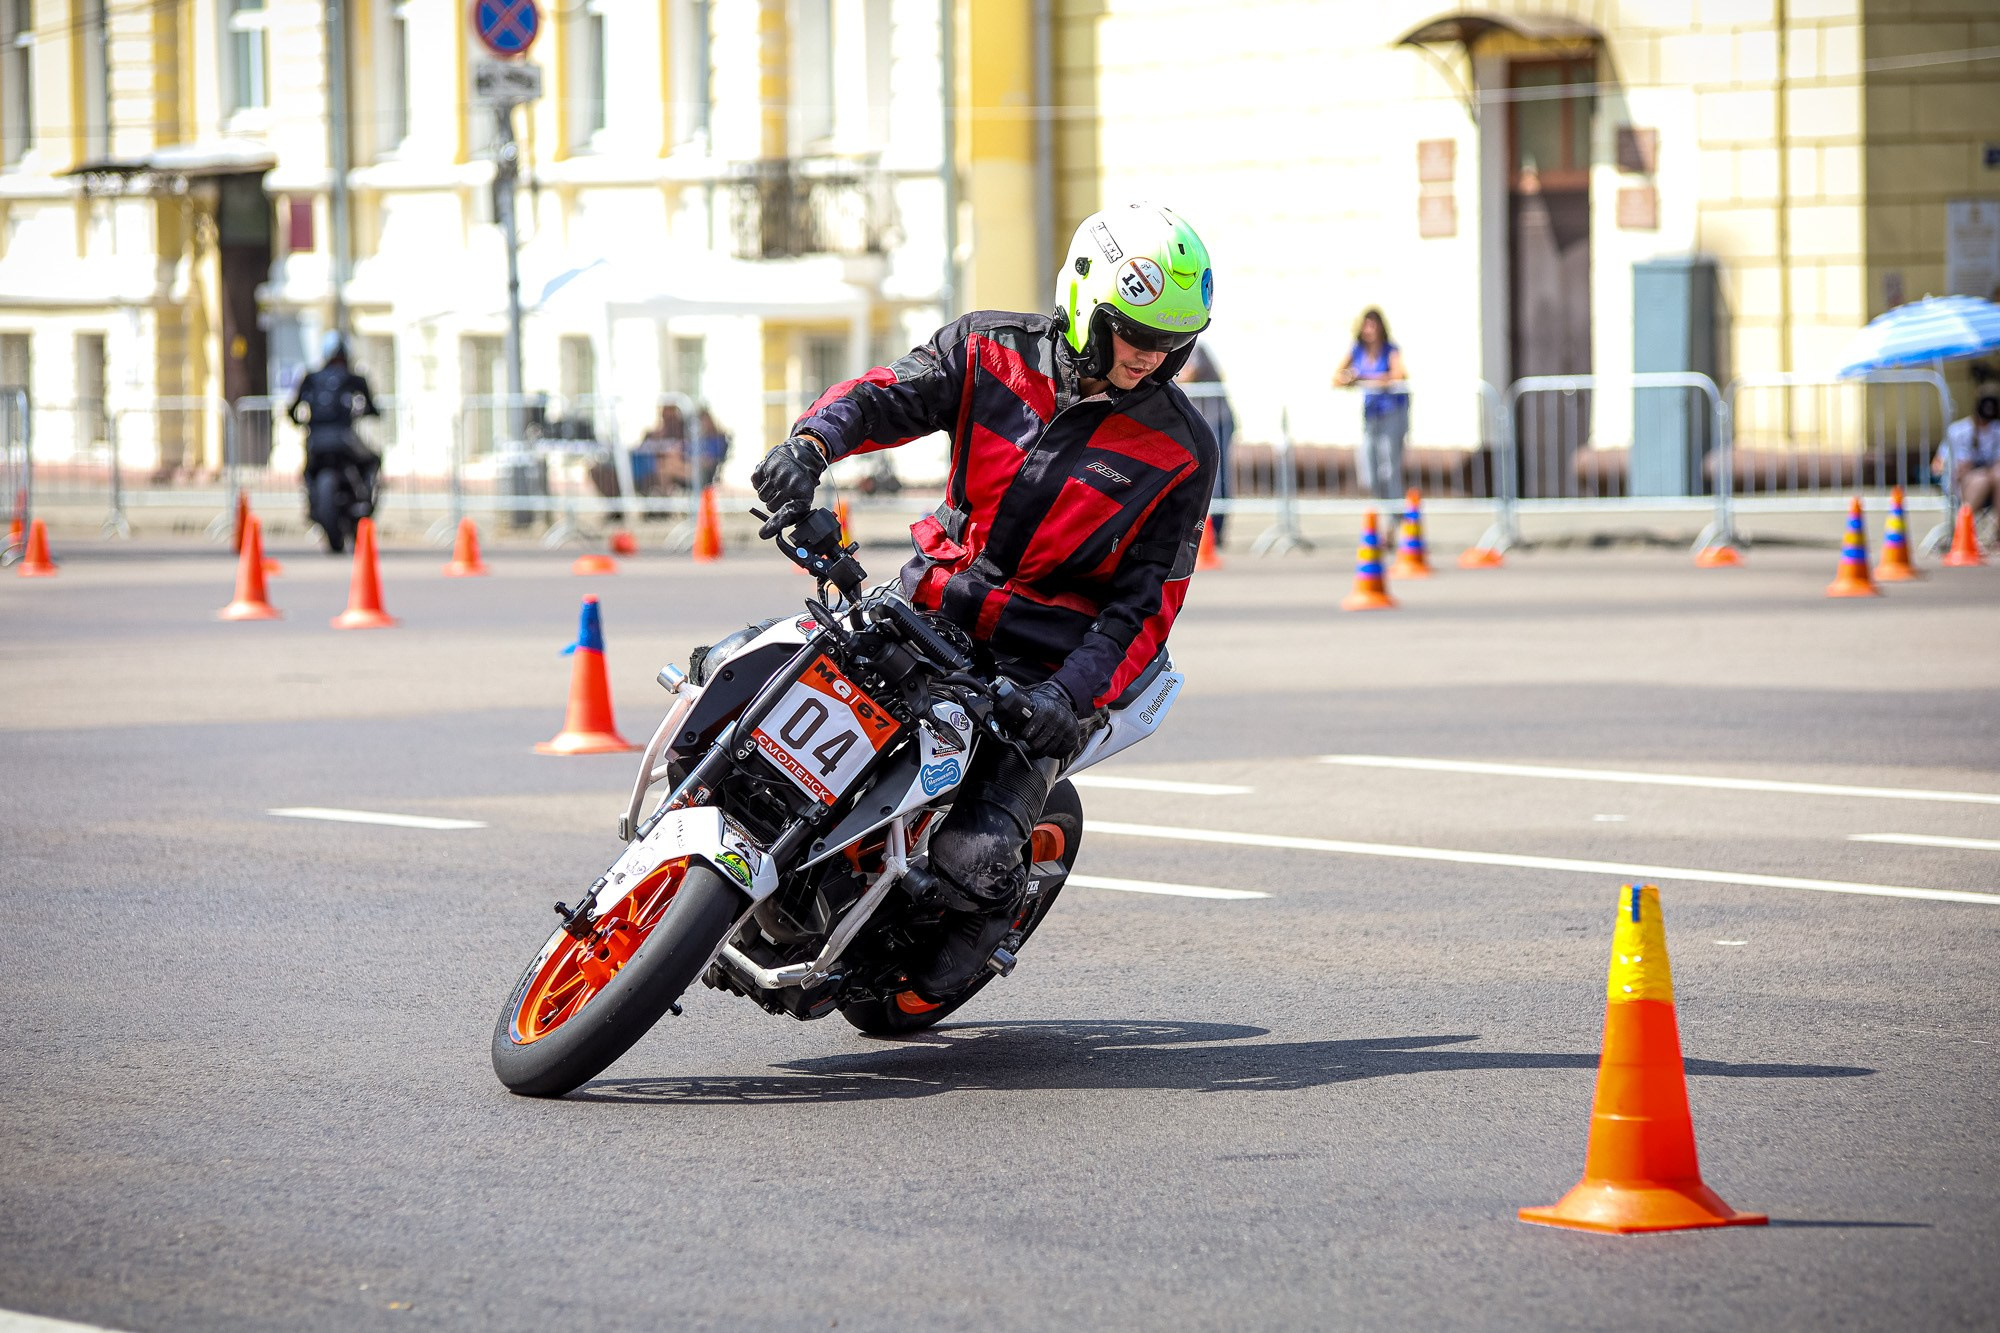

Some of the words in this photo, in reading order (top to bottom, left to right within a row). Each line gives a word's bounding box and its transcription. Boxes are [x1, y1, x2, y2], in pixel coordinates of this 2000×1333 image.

[1121, 273, 1146, 299] 12
[1085, 461, 1132, 485] RST
[779, 697, 860, 778] 04
[757, 734, 831, 801] СМОЛЕНСК
